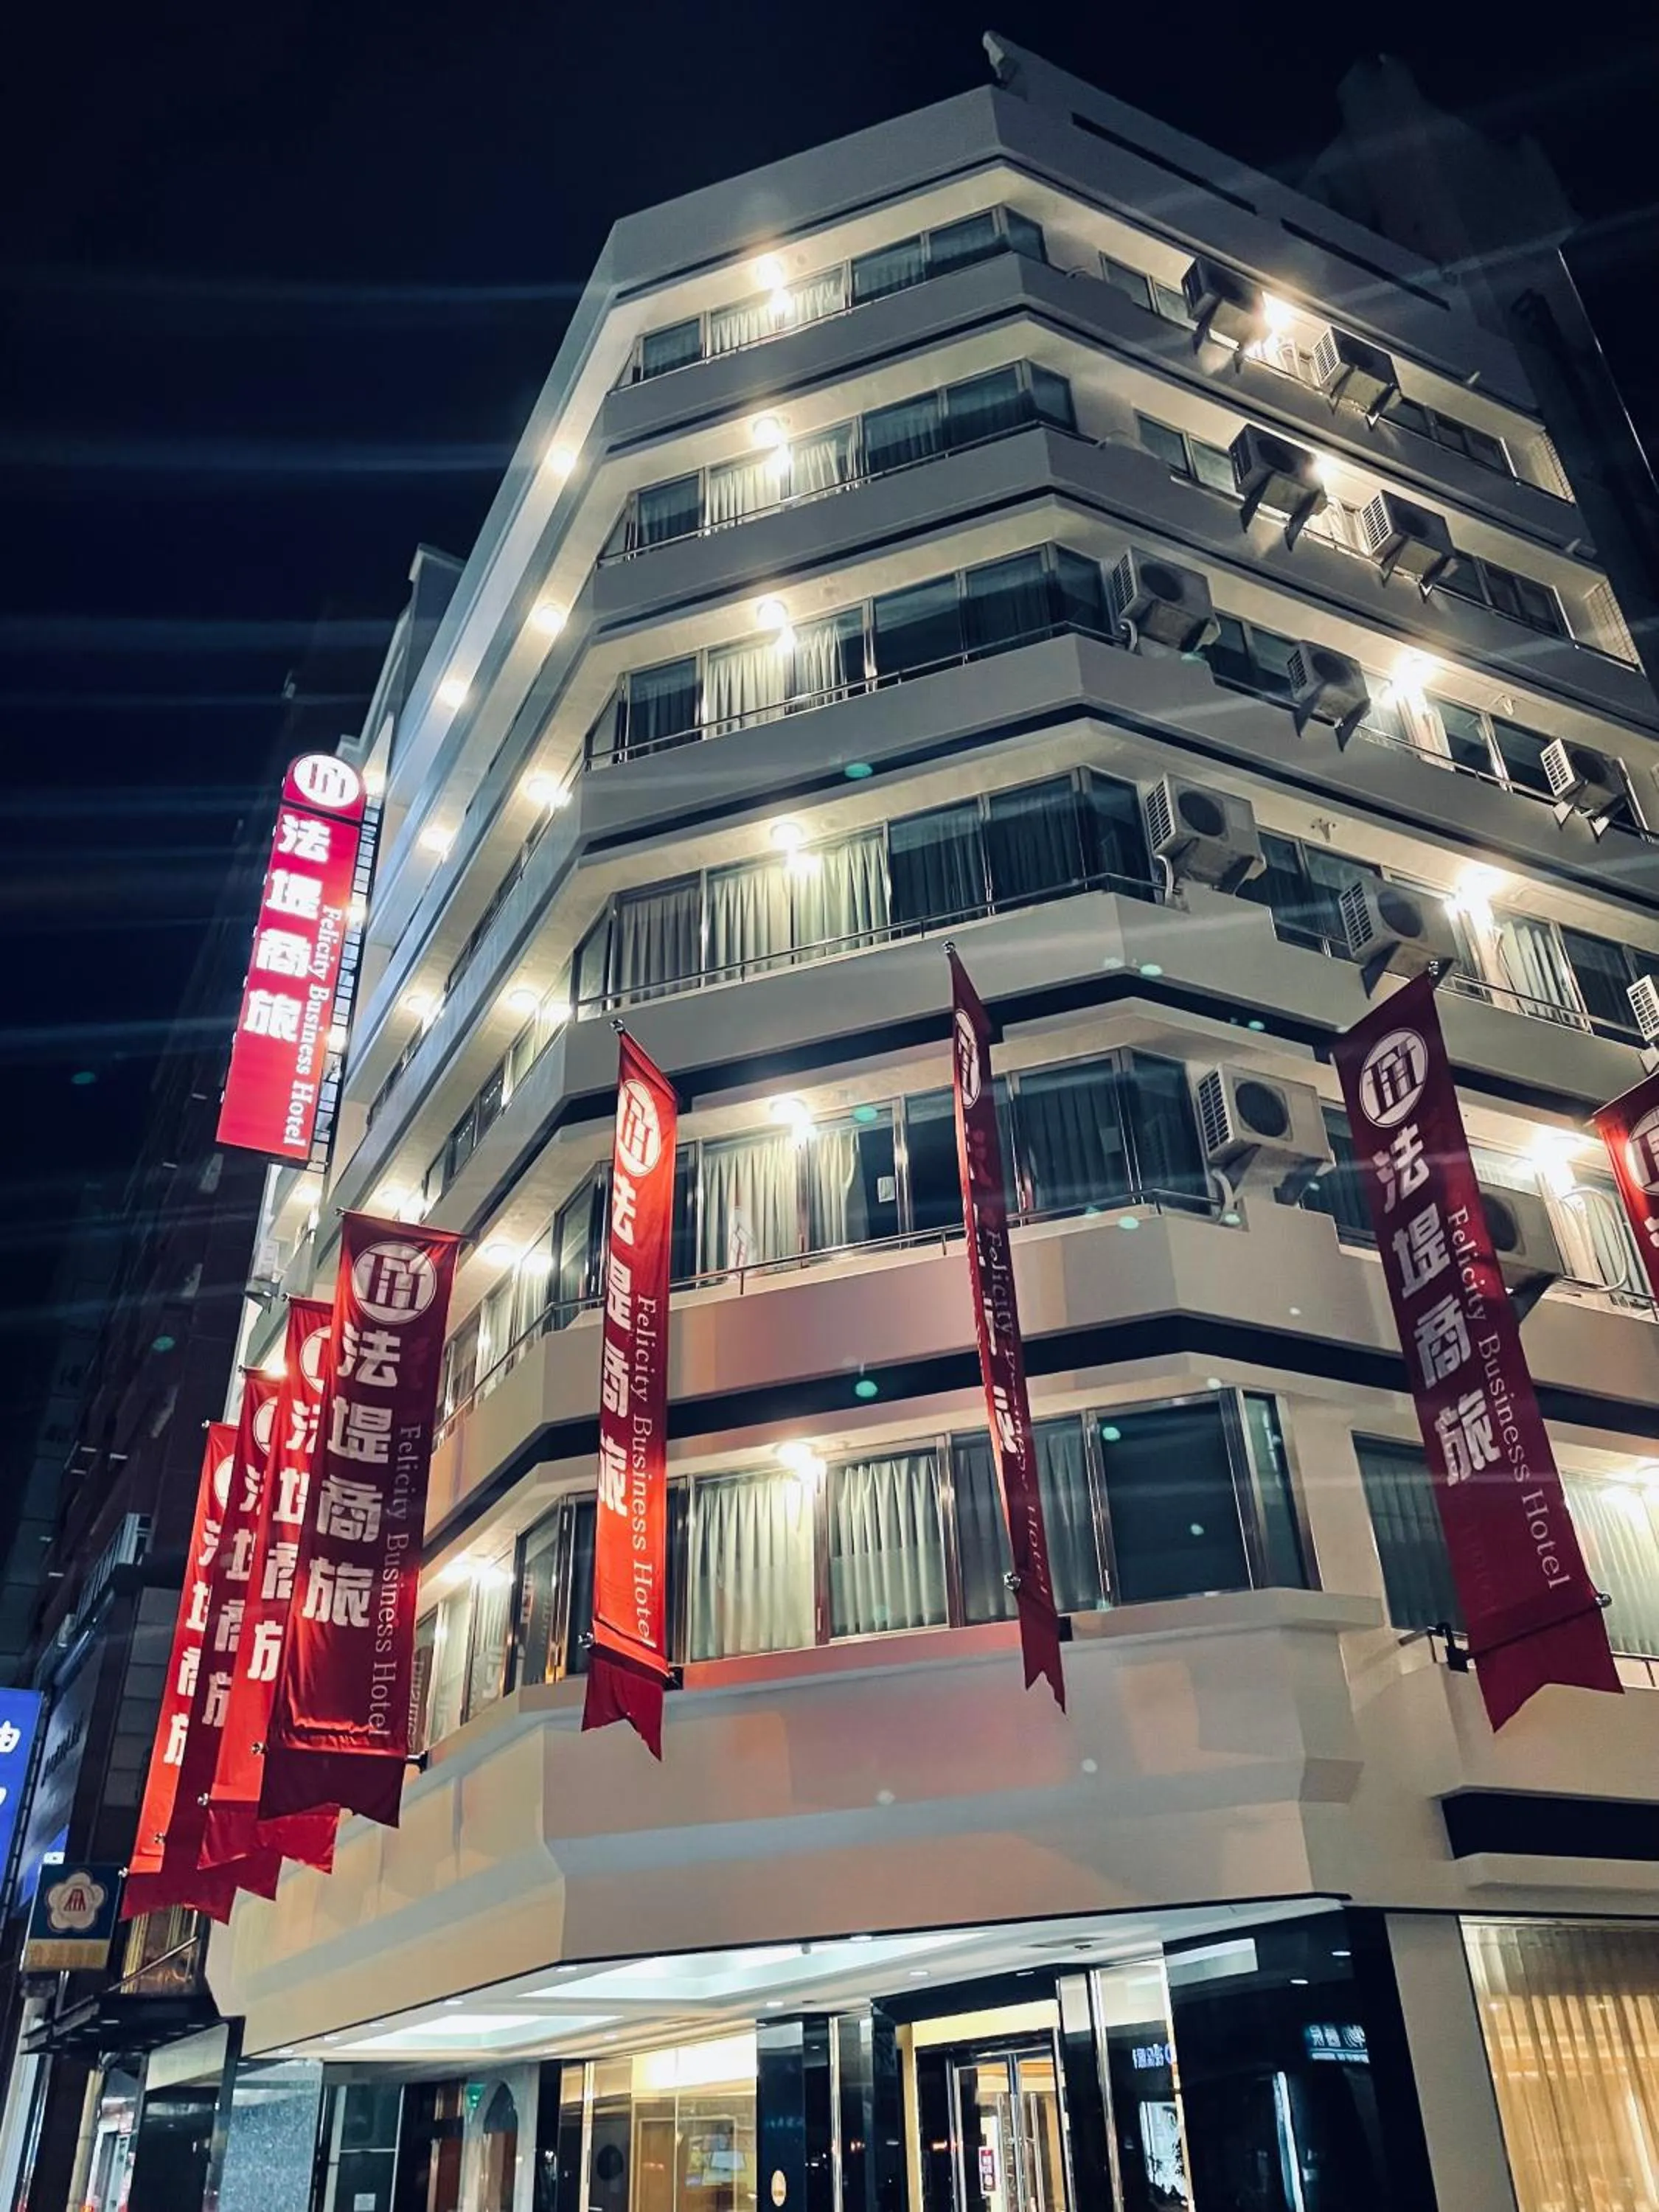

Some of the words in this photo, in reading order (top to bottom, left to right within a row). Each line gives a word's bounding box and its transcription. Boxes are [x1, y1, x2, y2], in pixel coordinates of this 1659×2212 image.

[309, 905, 341, 981] Felicity
[298, 984, 330, 1076] Business
[283, 1081, 314, 1147] Hotel
[630, 1293, 657, 1402] Felicity
[1372, 1124, 1501, 1488] 法堤商旅
[1447, 1203, 1487, 1324] Felicity
[1478, 1332, 1530, 1485] Business
[1522, 1491, 1571, 1590] Hotel
[300, 1320, 402, 1629] 法堤商旅
[385, 1423, 422, 1523] Felicity
[632, 1414, 653, 1551] Business
[375, 1532, 411, 1655] Business
[631, 1558, 658, 1646] Hotel
[369, 1659, 397, 1738] Hotel
